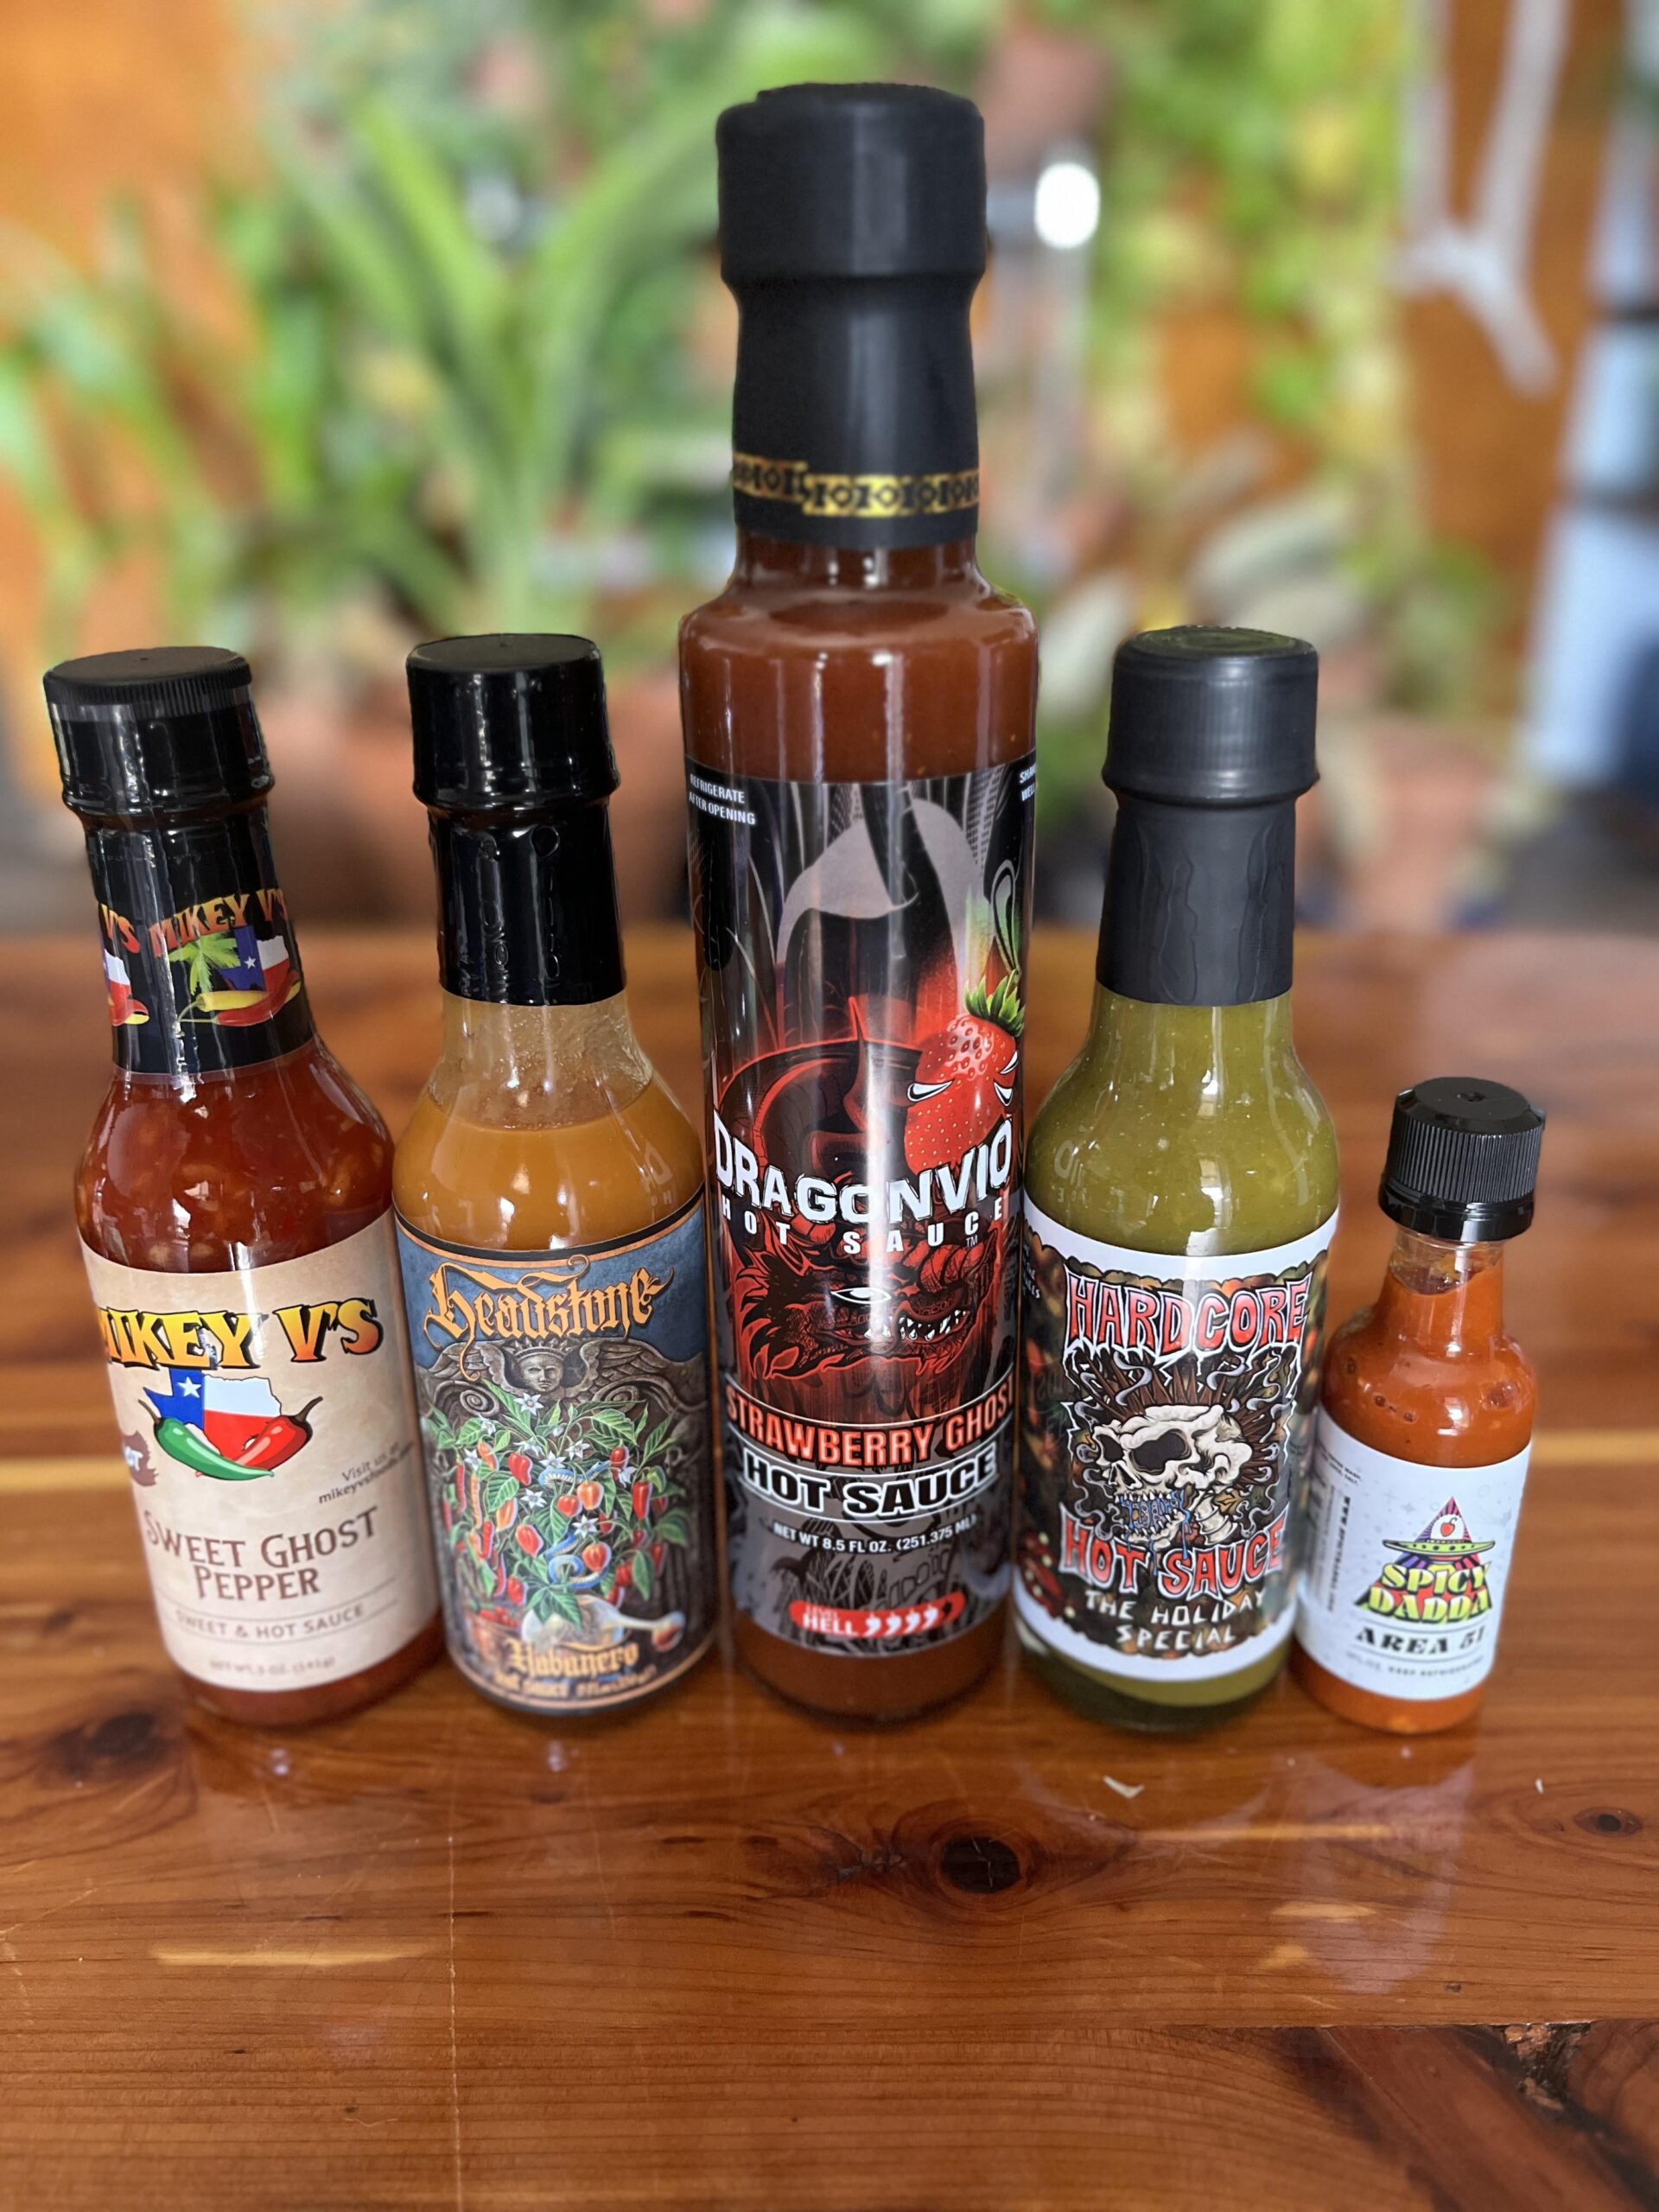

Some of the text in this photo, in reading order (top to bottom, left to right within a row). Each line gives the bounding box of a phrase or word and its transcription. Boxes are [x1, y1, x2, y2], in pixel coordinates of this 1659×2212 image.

[690, 774, 746, 804] REFRIGERATE
[689, 791, 756, 825] AFTER OPENING
[149, 893, 251, 958] MIKEY
[714, 1110, 1013, 1224] DRAGONVIO
[721, 1196, 1003, 1255] HOT SAUCE
[273, 1297, 385, 1363] V'S
[1065, 1267, 1312, 1358] HARDCORE
[726, 1384, 935, 1467] STRAWBERRY
[341, 1461, 372, 1482] Visit
[743, 1441, 998, 1517] HOT SAUCE
[143, 1505, 378, 1568] SWEET GHOST
[772, 1522, 797, 1542] NET
[798, 1531, 819, 1548] WT
[822, 1537, 846, 1552] 8.5
[849, 1540, 866, 1553] FL
[1059, 1505, 1150, 1594] HOT
[1158, 1503, 1288, 1600] SAUCE
[194, 1565, 321, 1602] PEPPER
[1381, 1561, 1492, 1596] SPICY
[257, 1623, 296, 1638] HOT
[304, 1603, 365, 1634] SAUCE
[802, 1612, 859, 1637] HELL
[1084, 1590, 1266, 1626] THE HOLIDAY
[1116, 1624, 1236, 1651] SPECIAL
[1356, 1626, 1448, 1656] AREA
